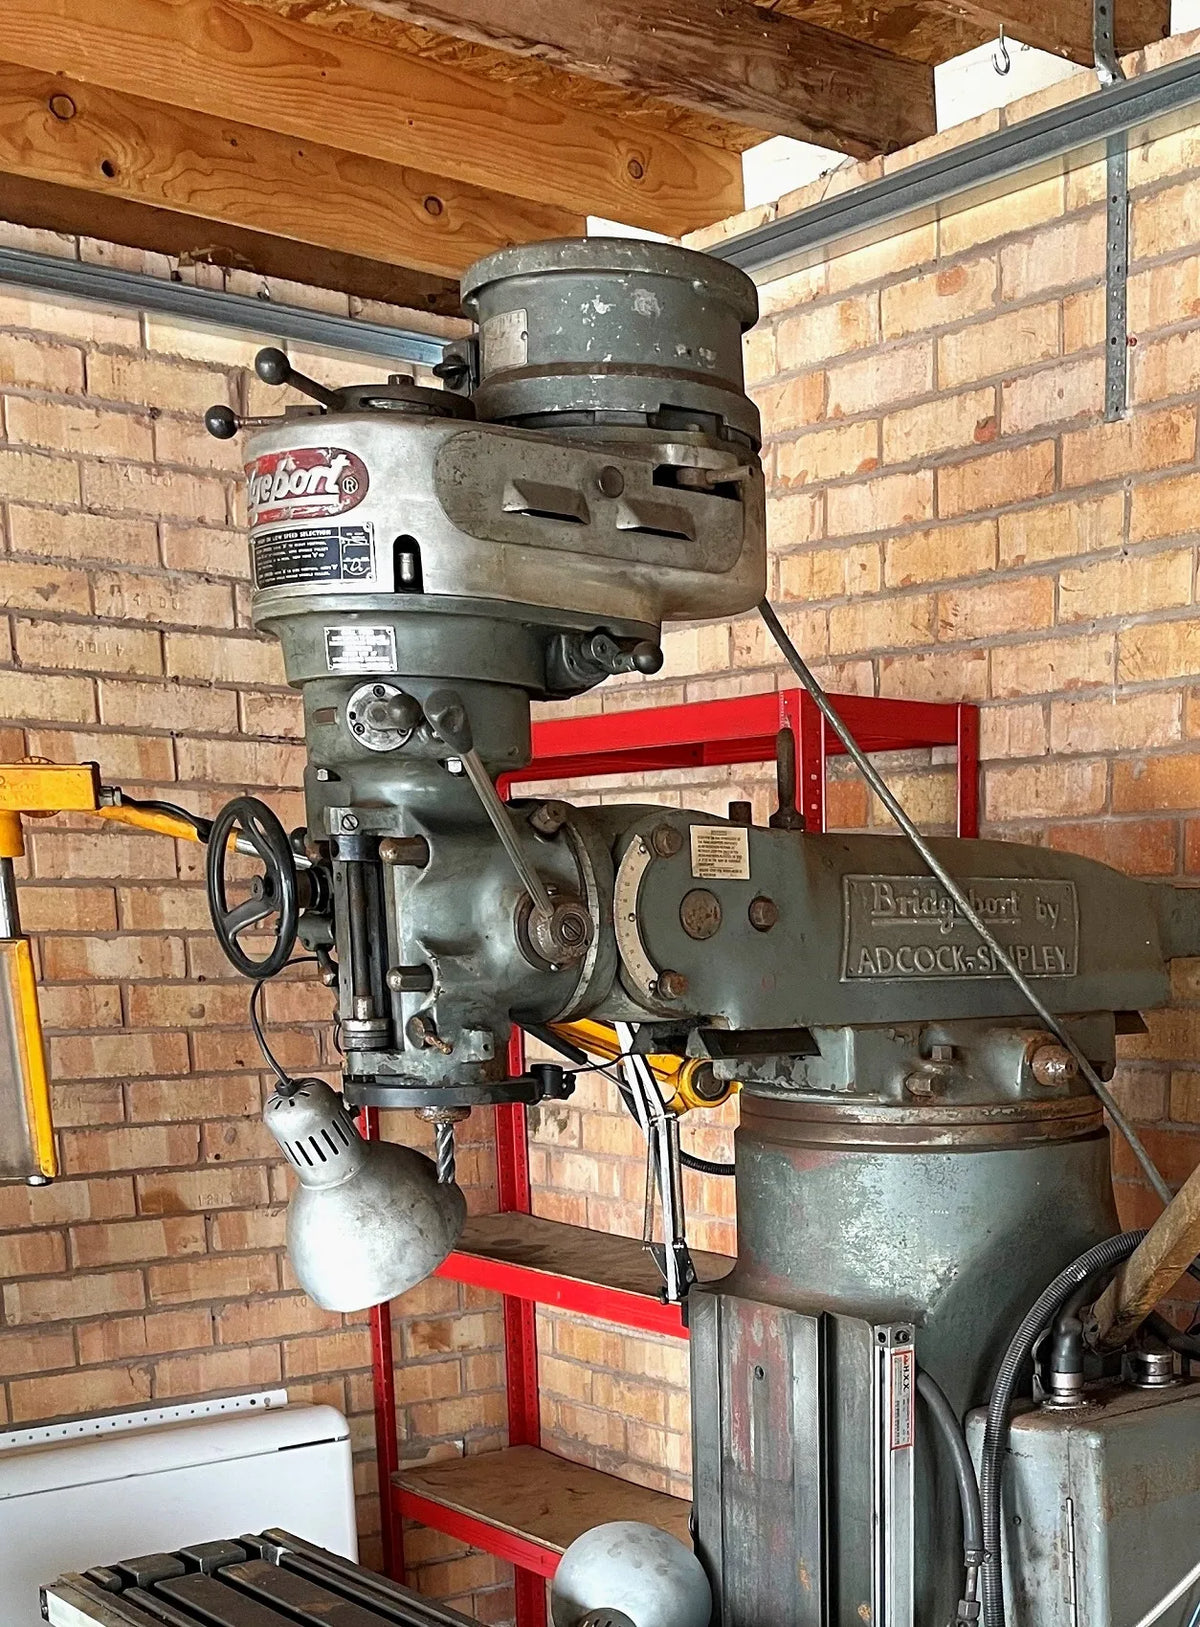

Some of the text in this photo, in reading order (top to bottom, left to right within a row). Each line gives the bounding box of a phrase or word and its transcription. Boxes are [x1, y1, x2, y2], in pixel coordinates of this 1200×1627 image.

[283, 531, 299, 540] SPEED
[299, 529, 332, 538] SELECTION
[1035, 895, 1060, 929] by
